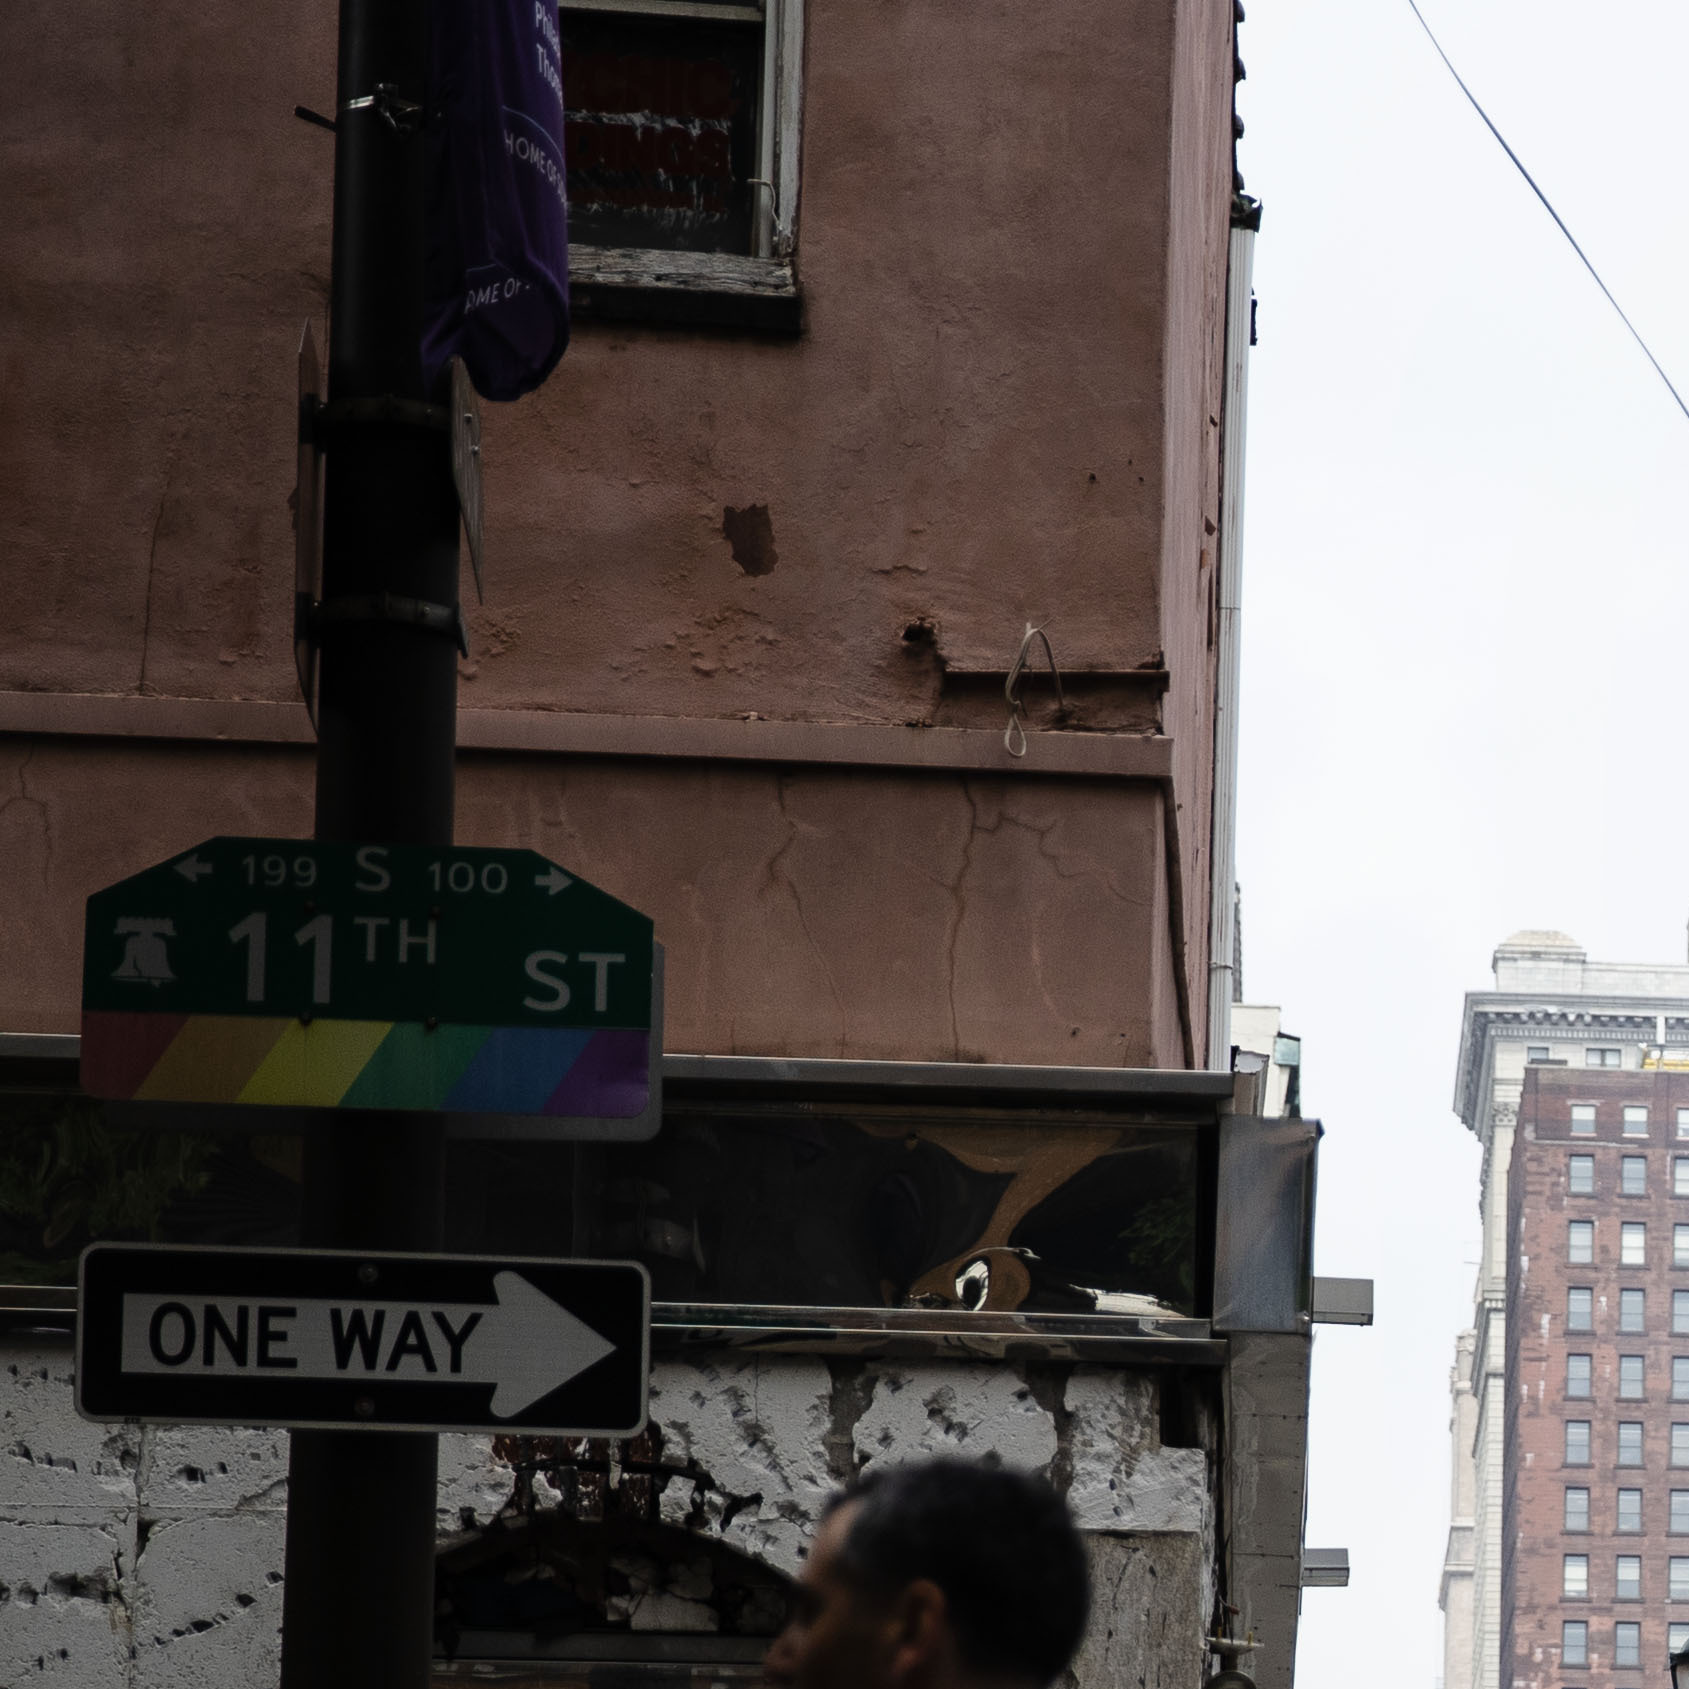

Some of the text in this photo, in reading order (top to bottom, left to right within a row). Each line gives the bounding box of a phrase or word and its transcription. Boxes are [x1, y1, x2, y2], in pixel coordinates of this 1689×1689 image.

[504, 129, 546, 175] HOME
[241, 846, 509, 894] 199 S 100
[229, 911, 626, 1012] 11TH ST
[148, 1301, 485, 1375] ONE WAY
